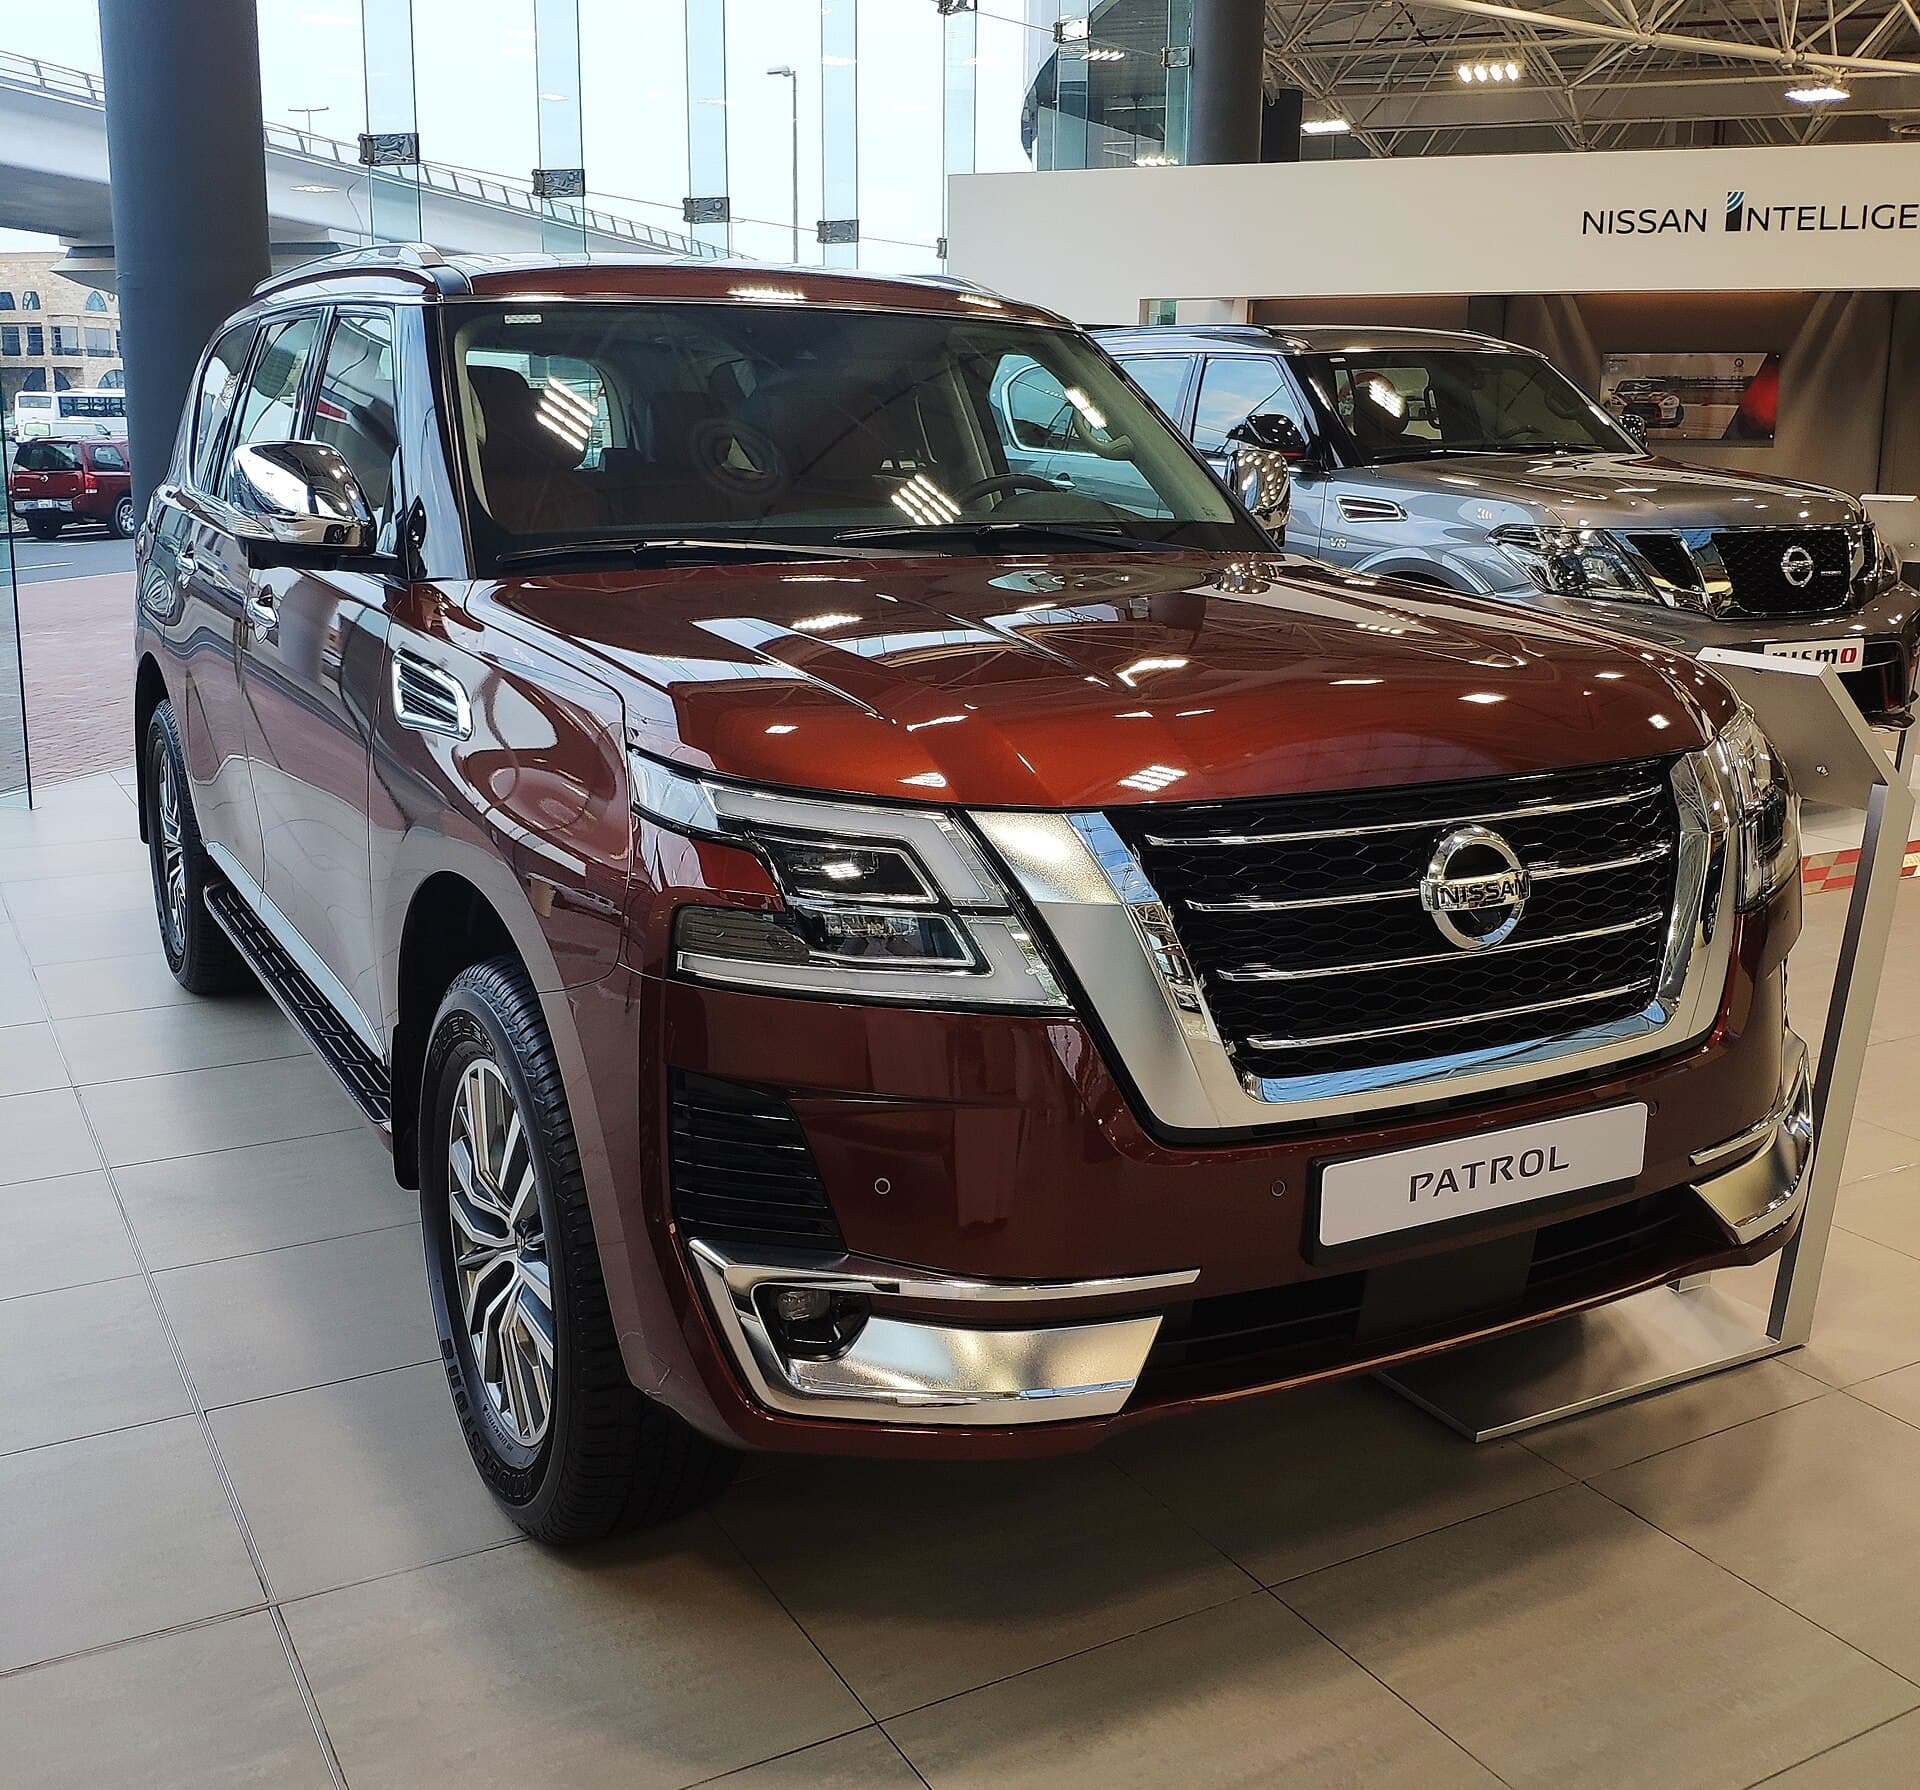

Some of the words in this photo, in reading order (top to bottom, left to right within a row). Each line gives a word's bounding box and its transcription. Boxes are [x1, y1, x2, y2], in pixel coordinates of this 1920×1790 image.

[1582, 208, 1708, 235] NISSAN
[1431, 871, 1531, 910] NISSAN
[1409, 1146, 1569, 1202] PATROL
